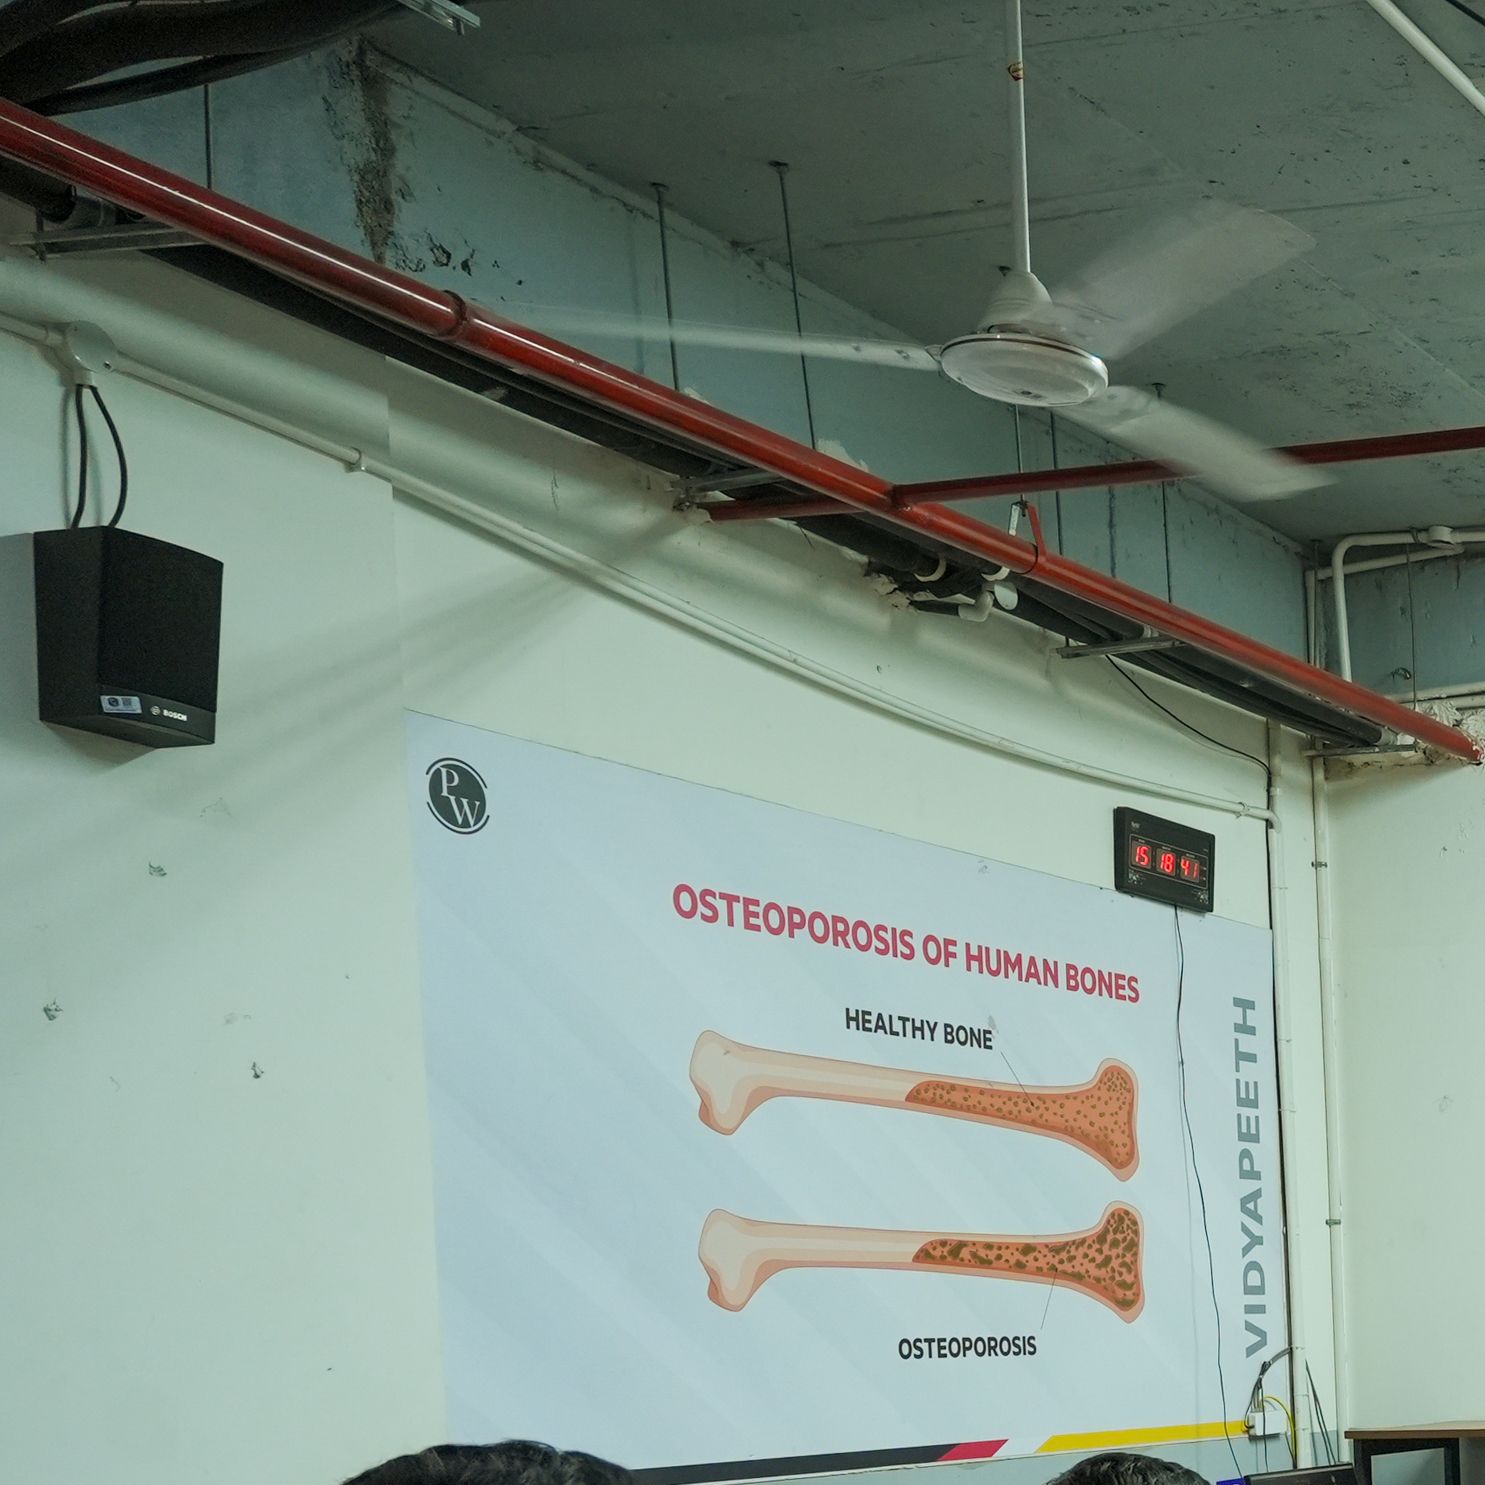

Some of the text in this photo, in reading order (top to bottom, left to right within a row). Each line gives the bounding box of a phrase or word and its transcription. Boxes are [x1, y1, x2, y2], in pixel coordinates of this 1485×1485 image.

[163, 709, 187, 721] BOSCH
[438, 764, 483, 830] PW
[1136, 845, 1199, 880] 15 18 41
[673, 883, 1140, 1003] OSTEOPOROSIS OF HUMAN BONES
[845, 1007, 993, 1050] HEALTHY BONE
[1232, 997, 1268, 1358] VIDYAPEETH
[897, 1334, 1037, 1361] OSTEOPOROSIS
